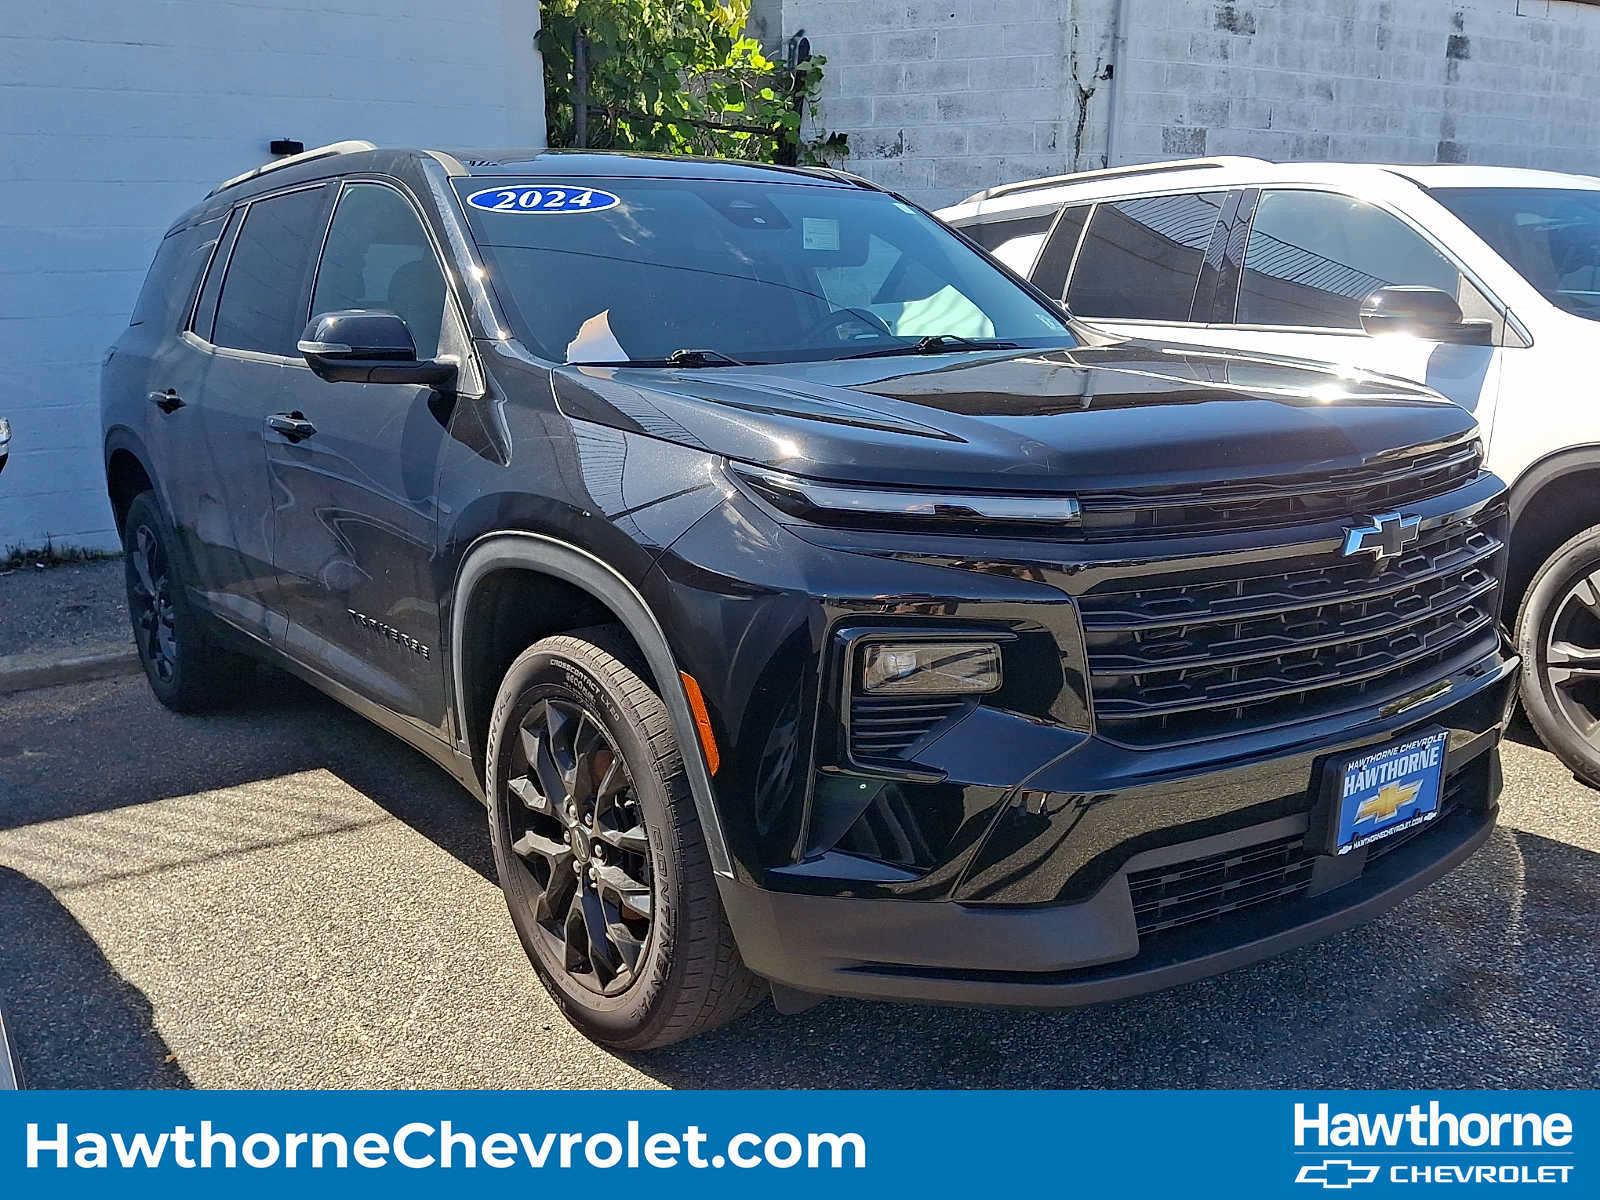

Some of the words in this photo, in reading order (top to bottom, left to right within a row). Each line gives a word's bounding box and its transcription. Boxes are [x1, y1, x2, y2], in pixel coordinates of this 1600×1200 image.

[492, 189, 593, 209] 2024
[1343, 746, 1440, 798] HAWTHORNE
[1348, 747, 1399, 771] HAWTHORNE
[1400, 731, 1449, 753] CHEVROLET
[631, 824, 671, 1021] CONTINENTAL
